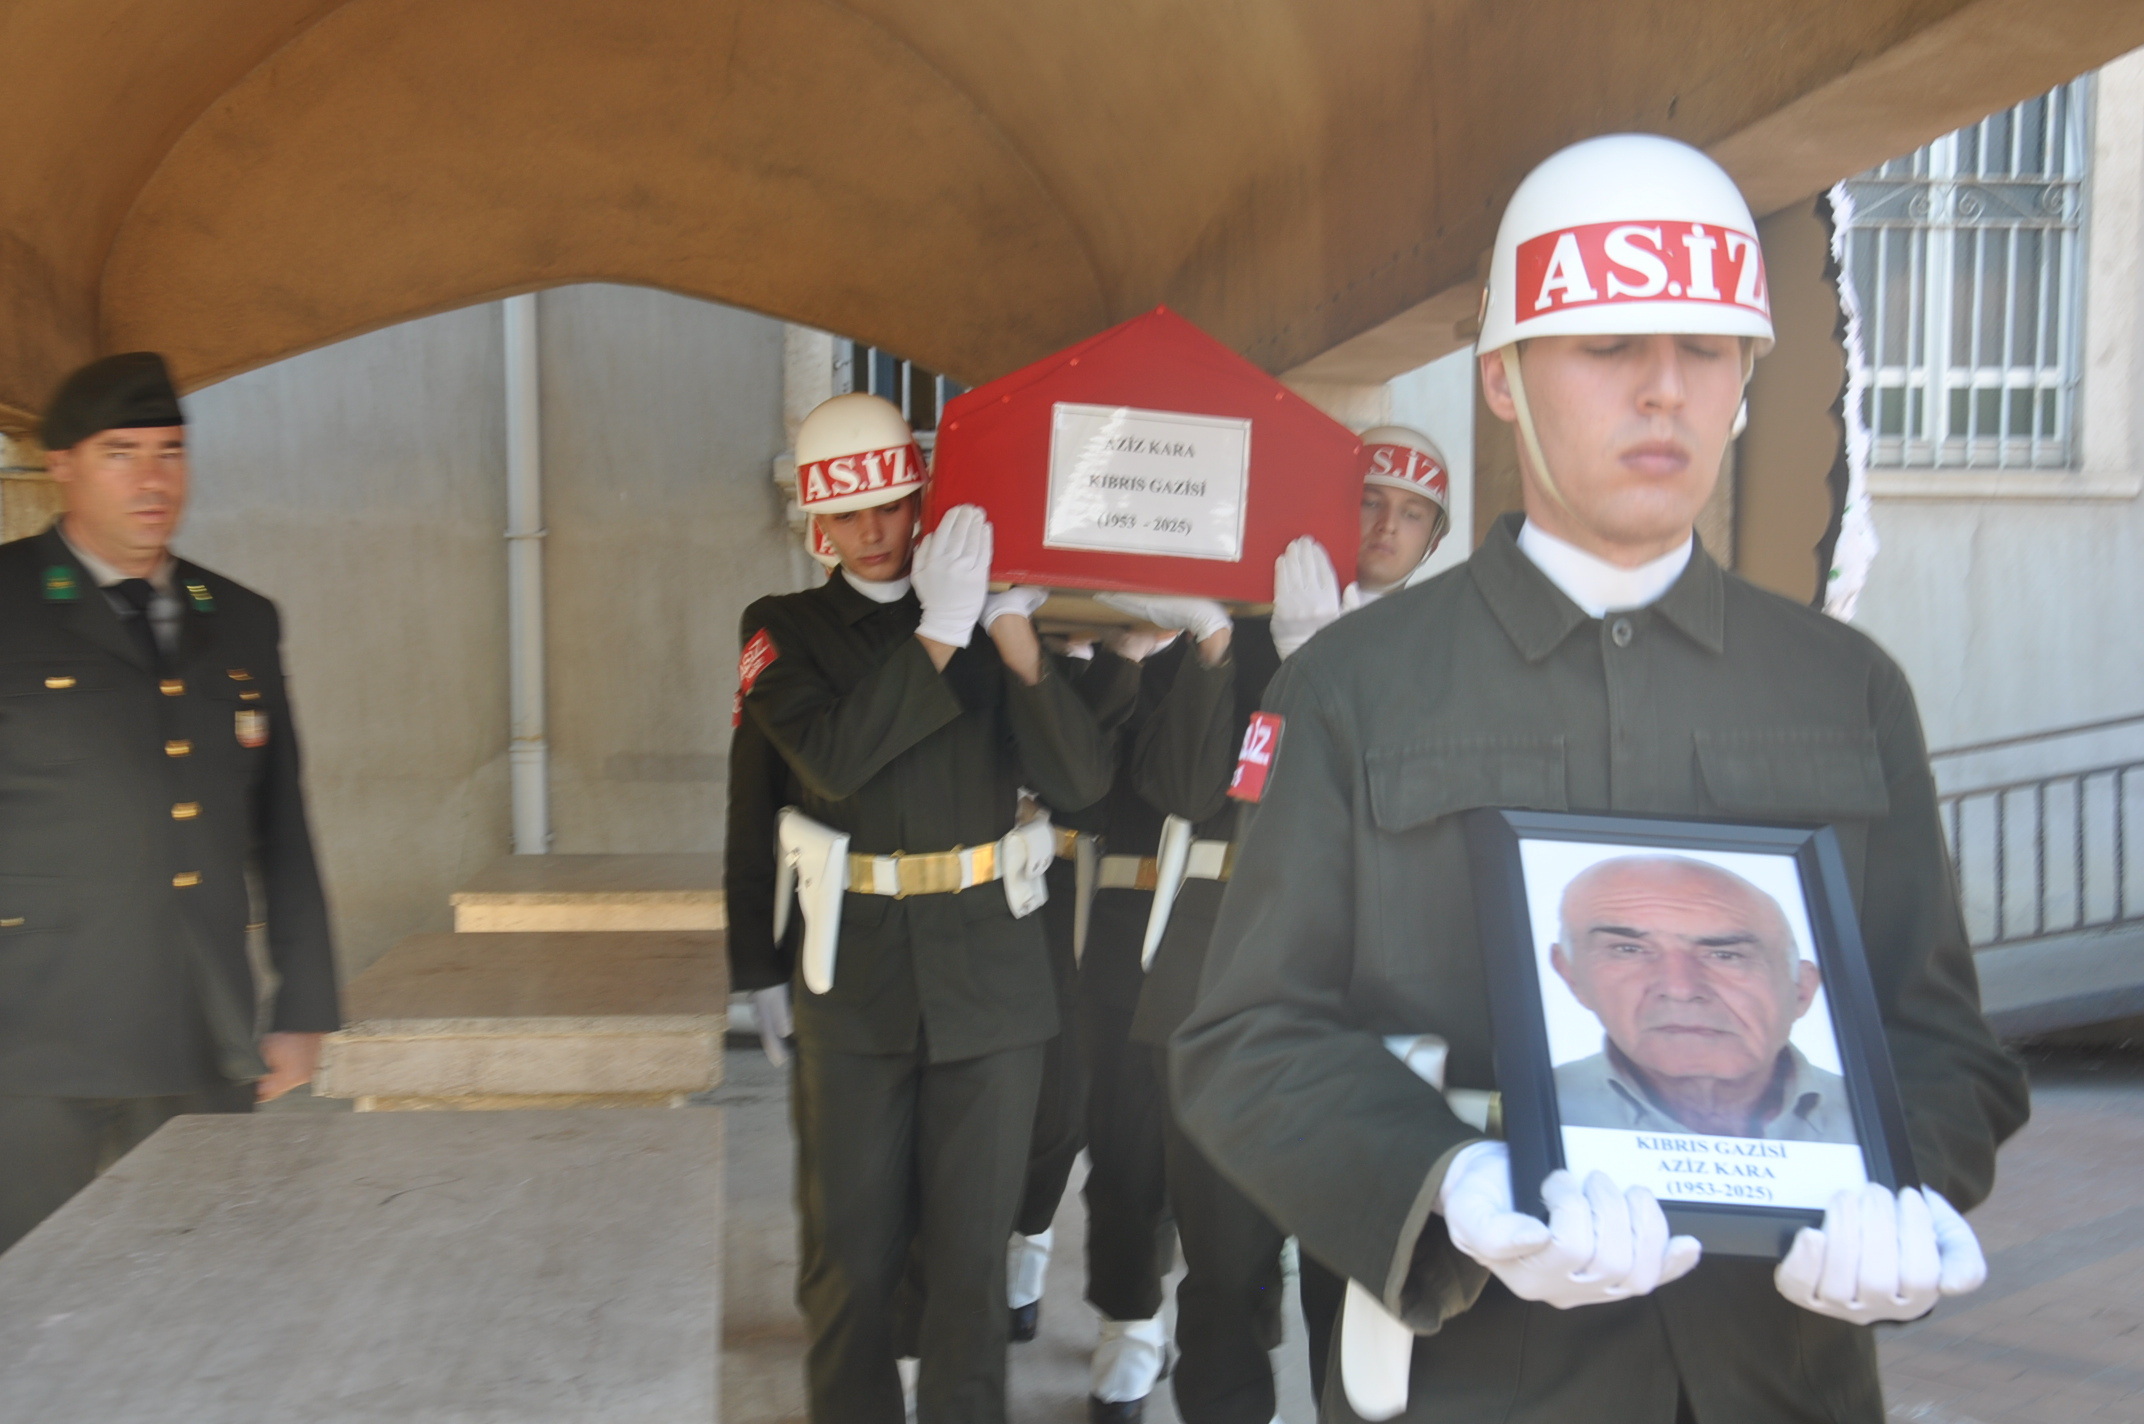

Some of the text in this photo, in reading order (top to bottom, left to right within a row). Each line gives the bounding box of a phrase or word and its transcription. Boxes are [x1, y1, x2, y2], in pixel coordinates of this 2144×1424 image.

[1104, 435, 1196, 459] AZİZ KARA
[1089, 474, 1207, 497] KIBRIS GAZİSİ
[1097, 512, 1137, 530] (1953
[1153, 515, 1193, 537] 2025)
[1635, 1135, 1789, 1159] KIBRIS GAZİSİ
[1658, 1157, 1776, 1179] AZİZ KARA
[1667, 1180, 1773, 1201] (1953-2025)
